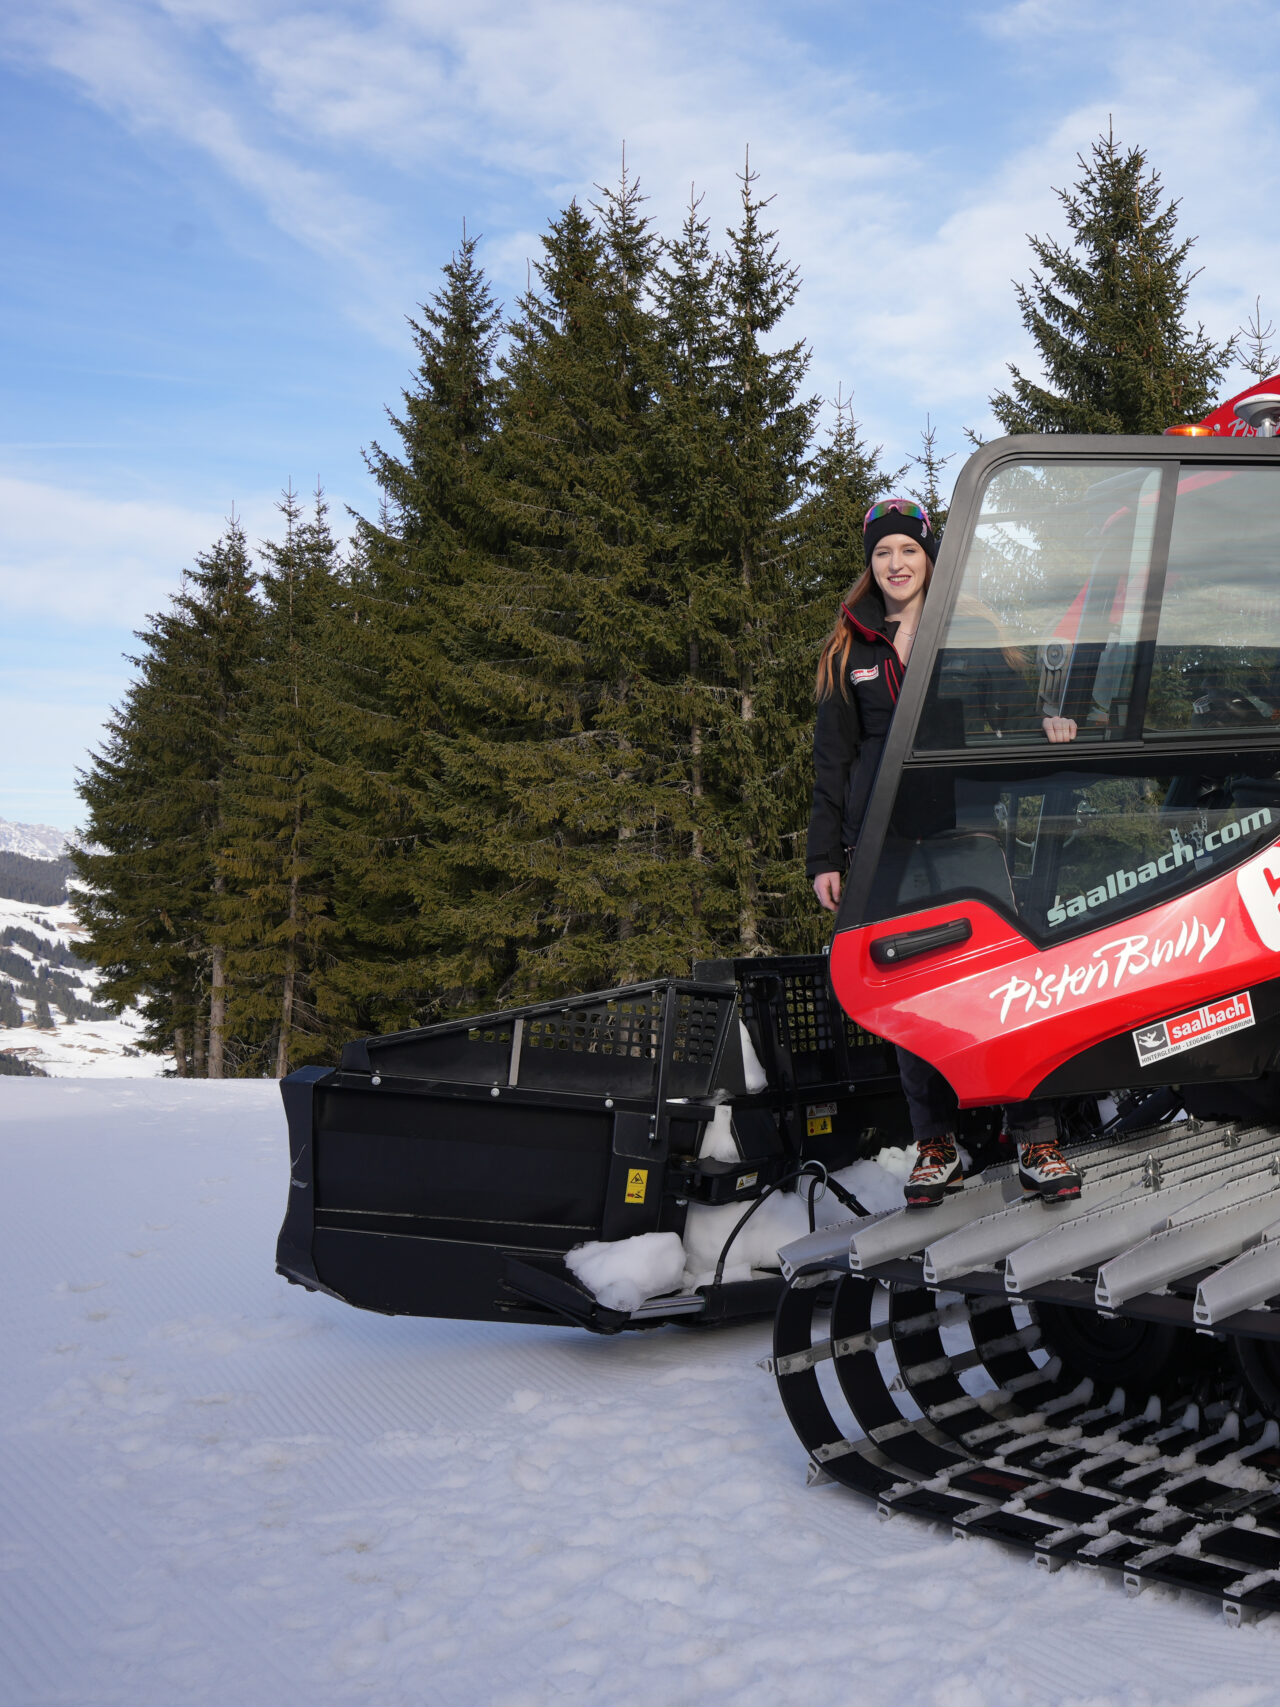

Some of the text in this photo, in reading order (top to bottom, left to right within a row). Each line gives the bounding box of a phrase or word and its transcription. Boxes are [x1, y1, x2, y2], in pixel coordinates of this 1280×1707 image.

[1046, 807, 1273, 927] saalbach.com
[989, 915, 1226, 1024] PistenBully
[1141, 1044, 1182, 1064] HINTERGLEMM
[1186, 1033, 1212, 1048] LEOGANG
[1216, 1017, 1254, 1037] FIEBERBRUNN
[1171, 996, 1246, 1039] saalbach
